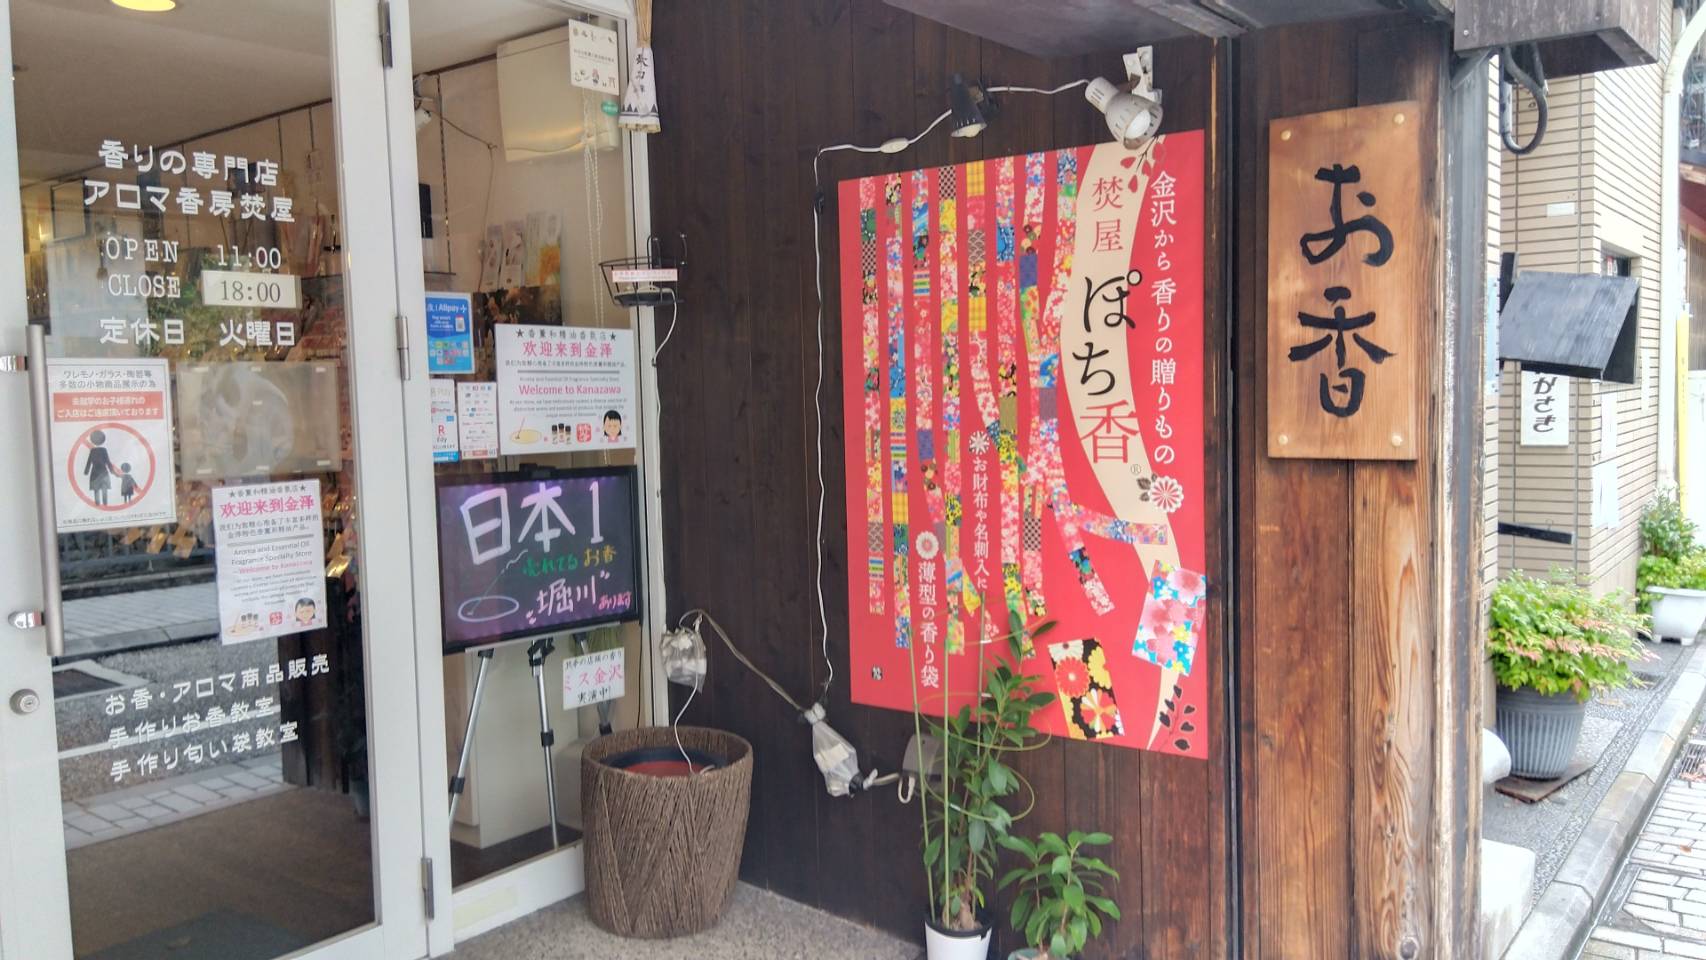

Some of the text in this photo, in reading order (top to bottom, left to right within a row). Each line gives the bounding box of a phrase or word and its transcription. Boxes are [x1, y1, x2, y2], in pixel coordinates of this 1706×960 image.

[98, 139, 279, 187] 香りの専門店
[83, 178, 296, 223] アロマ香房焚屋
[106, 236, 282, 269] OPEN 11:00
[108, 272, 281, 302] CLOSE 18:00
[1288, 163, 1398, 418] お香
[100, 318, 295, 347] 定休日 火曜日
[1073, 176, 1142, 463] 焚屋 ぽち香
[1150, 170, 1177, 464] 金沢から香りの贈りもの
[519, 385, 621, 395] Welcome to Kanazawa
[1532, 372, 1558, 433] がさき
[918, 561, 939, 689] 薄型の香り袋
[106, 653, 329, 716] お香・アロマ商品販売
[108, 697, 274, 749] 手作りお香教室
[110, 721, 299, 782] 手作り匂い袋教室
